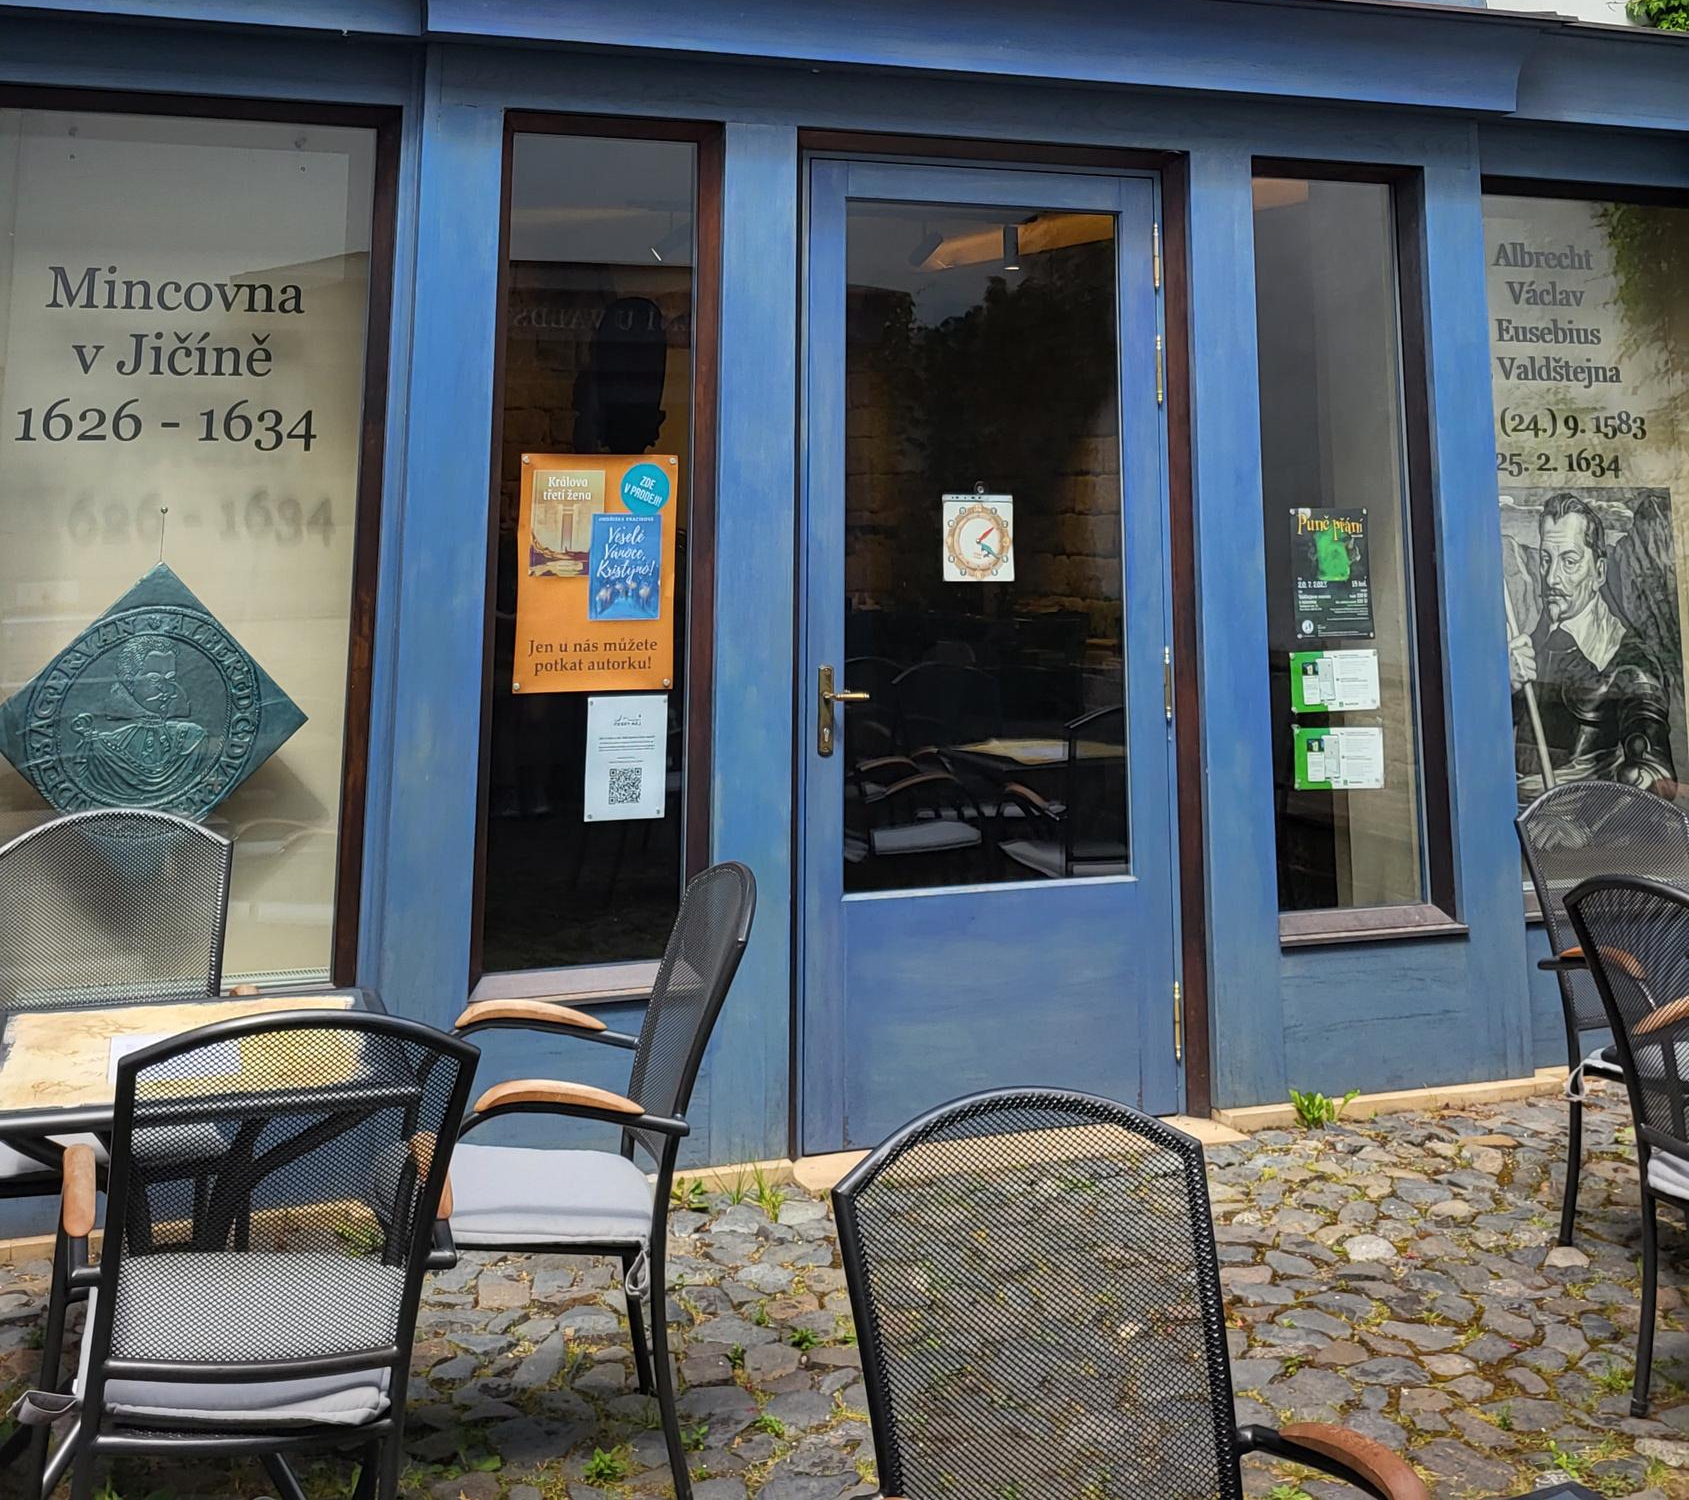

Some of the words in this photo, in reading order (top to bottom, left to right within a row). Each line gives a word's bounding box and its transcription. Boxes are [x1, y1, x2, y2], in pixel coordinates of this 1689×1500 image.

[1492, 242, 1594, 270] Albrecht
[45, 265, 304, 314] Mincovna
[1505, 281, 1585, 307] Václav
[1495, 319, 1602, 345] Eusebius
[72, 345, 104, 374] v
[116, 331, 272, 377] Jičíně
[1496, 356, 1622, 389] Valdštejna
[14, 398, 142, 441] 1626
[161, 421, 180, 429] -
[198, 399, 317, 452] 1634
[1500, 407, 1557, 439] (24.)
[1564, 415, 1586, 439] 9.
[1592, 410, 1647, 440] 1583
[1496, 453, 1530, 478] 25.
[1536, 452, 1558, 472] 2.
[1565, 448, 1622, 479] 1634
[543, 489, 566, 501] třetí
[567, 489, 592, 501] žena
[548, 476, 588, 488] Králova
[640, 476, 656, 490] ZDE
[528, 639, 553, 657] Jen
[560, 642, 568, 653] u
[573, 639, 598, 653] nás
[603, 637, 658, 652] můžete
[534, 658, 583, 676] potkat
[587, 656, 652, 671] autorku!
